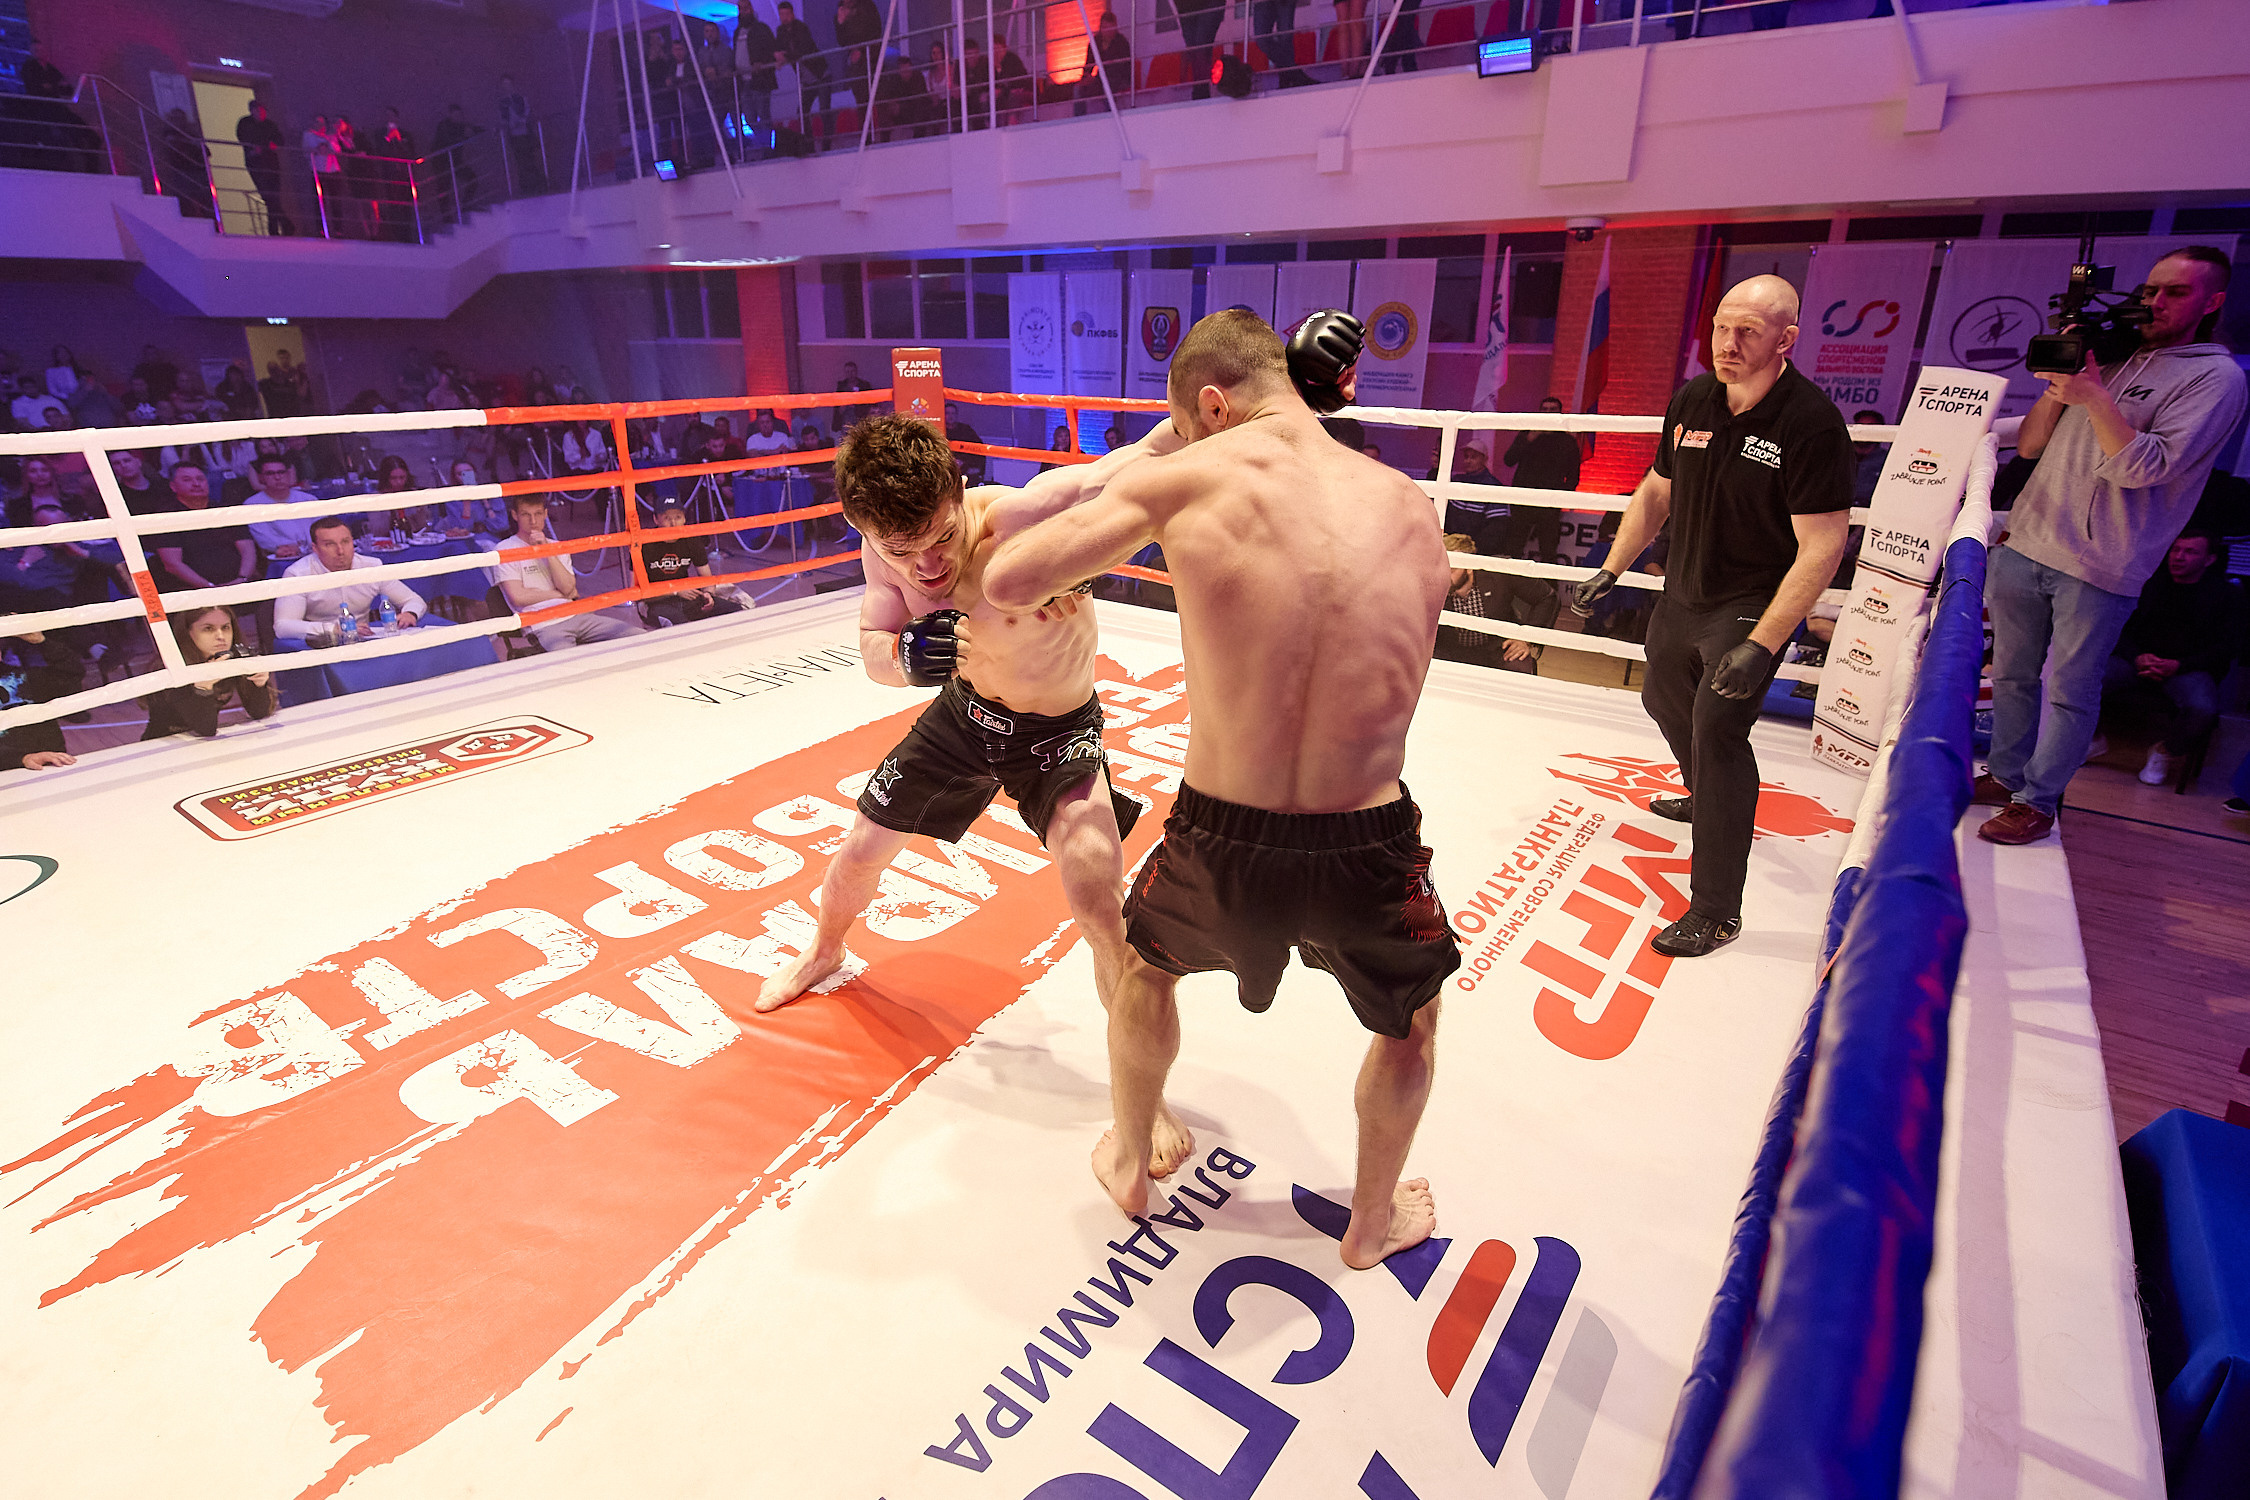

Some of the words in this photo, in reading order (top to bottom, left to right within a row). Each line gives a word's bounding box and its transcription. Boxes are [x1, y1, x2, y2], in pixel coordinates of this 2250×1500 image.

[1817, 355, 1886, 365] СПОРТСМЕНОВ
[1820, 344, 1888, 354] АССОЦИАЦИЯ
[904, 369, 941, 378] СПОРТА
[909, 361, 941, 369] АРЕНА
[1825, 386, 1879, 404] АМБО
[1940, 386, 1989, 402] АРЕНА
[1926, 399, 1983, 417] СПОРТА
[1747, 446, 1781, 465] СПОРТА
[1877, 542, 1926, 564] СПОРТА
[1886, 530, 1930, 551] АРЕНА
[903, 643, 912, 673] MFP
[1827, 743, 1871, 769] MFP
[218, 749, 421, 805] ИНТЕРНЕТ-МАГАЗИН
[231, 757, 451, 822] КУПИ
[250, 765, 458, 826] МЕБЕЛЬНЫЙ
[867, 778, 893, 807] Fairtex
[1545, 812, 1606, 881] ФЕДЕРАЦИЯ
[1452, 798, 1585, 956] ПАНКРАТИО
[1457, 876, 1554, 992] СОВРЕМЕННОГО
[1520, 822, 1693, 1061] MFP
[924, 1146, 1257, 1473] ВЛАДИМИРА
